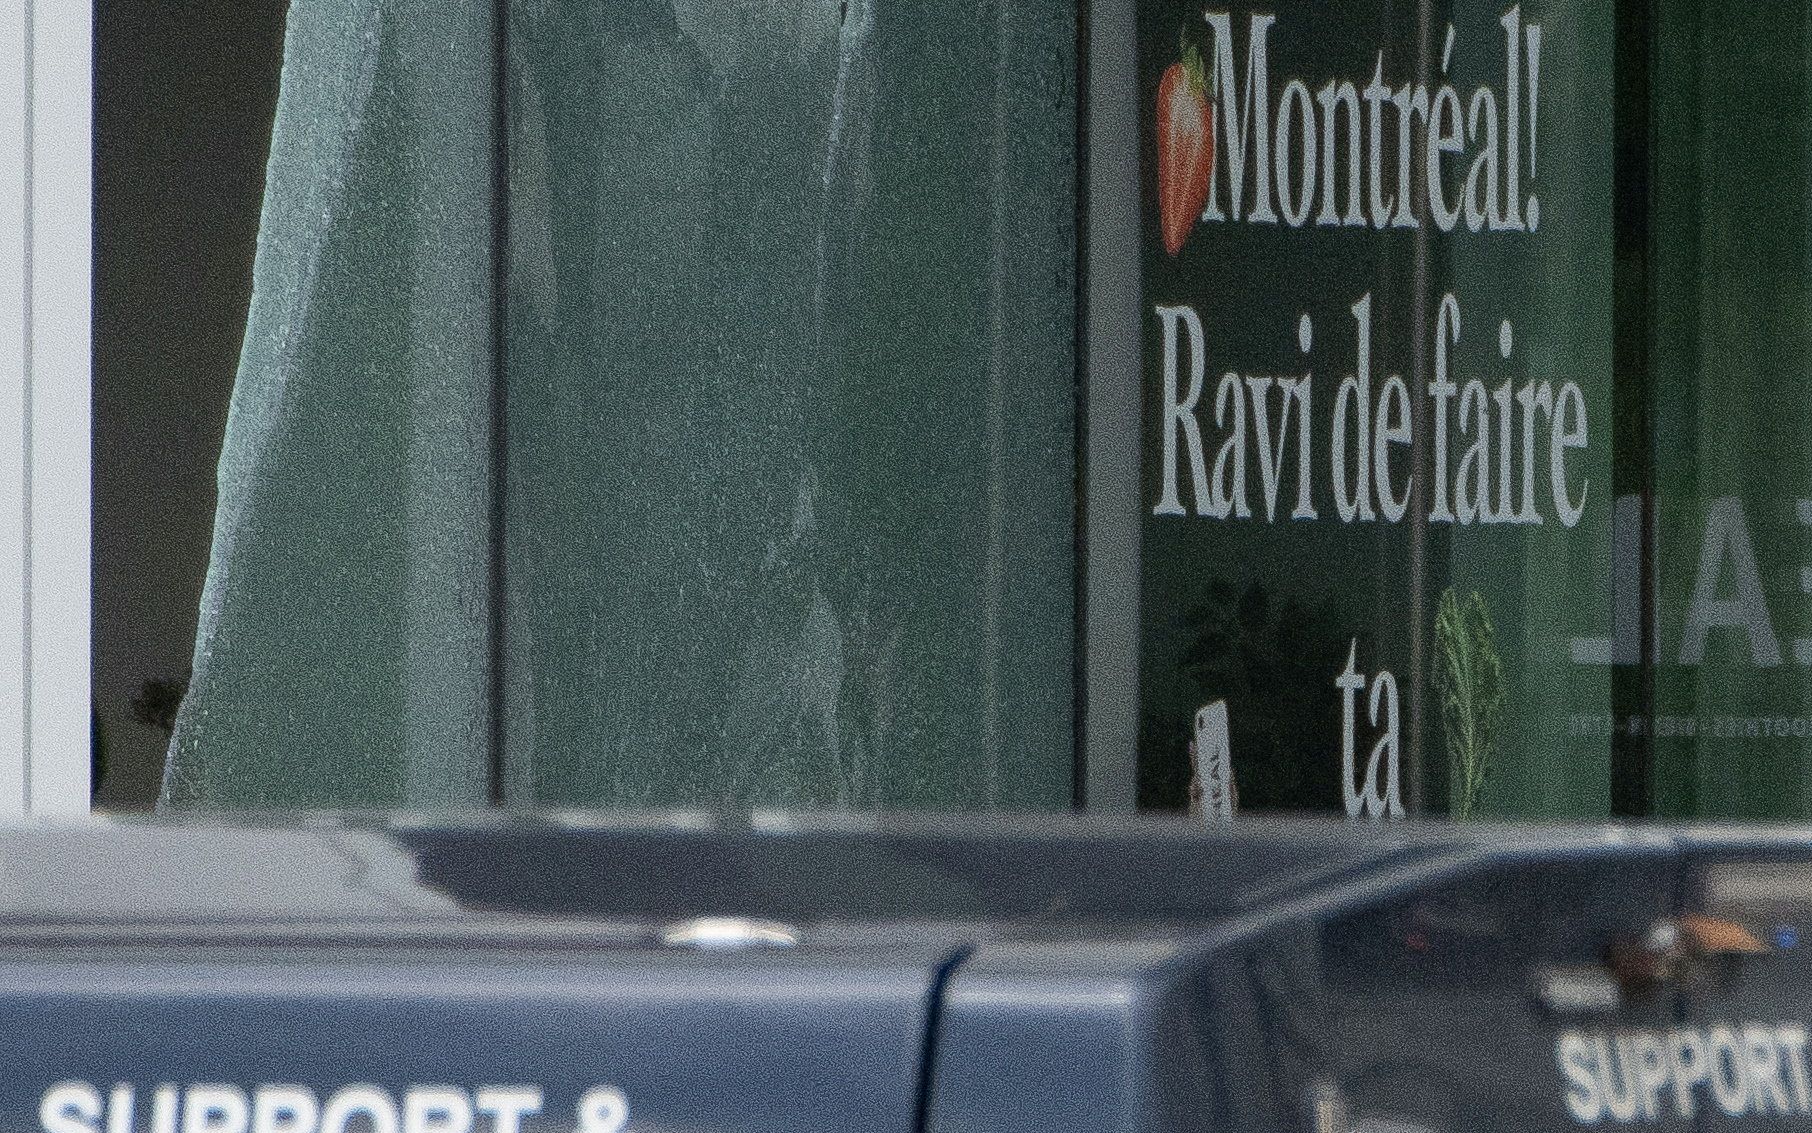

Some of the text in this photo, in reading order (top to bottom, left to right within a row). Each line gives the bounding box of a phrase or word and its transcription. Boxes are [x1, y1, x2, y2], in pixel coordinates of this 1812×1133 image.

[1202, 4, 1543, 234] Montréal!
[1153, 293, 1589, 528] Ravi de faire
